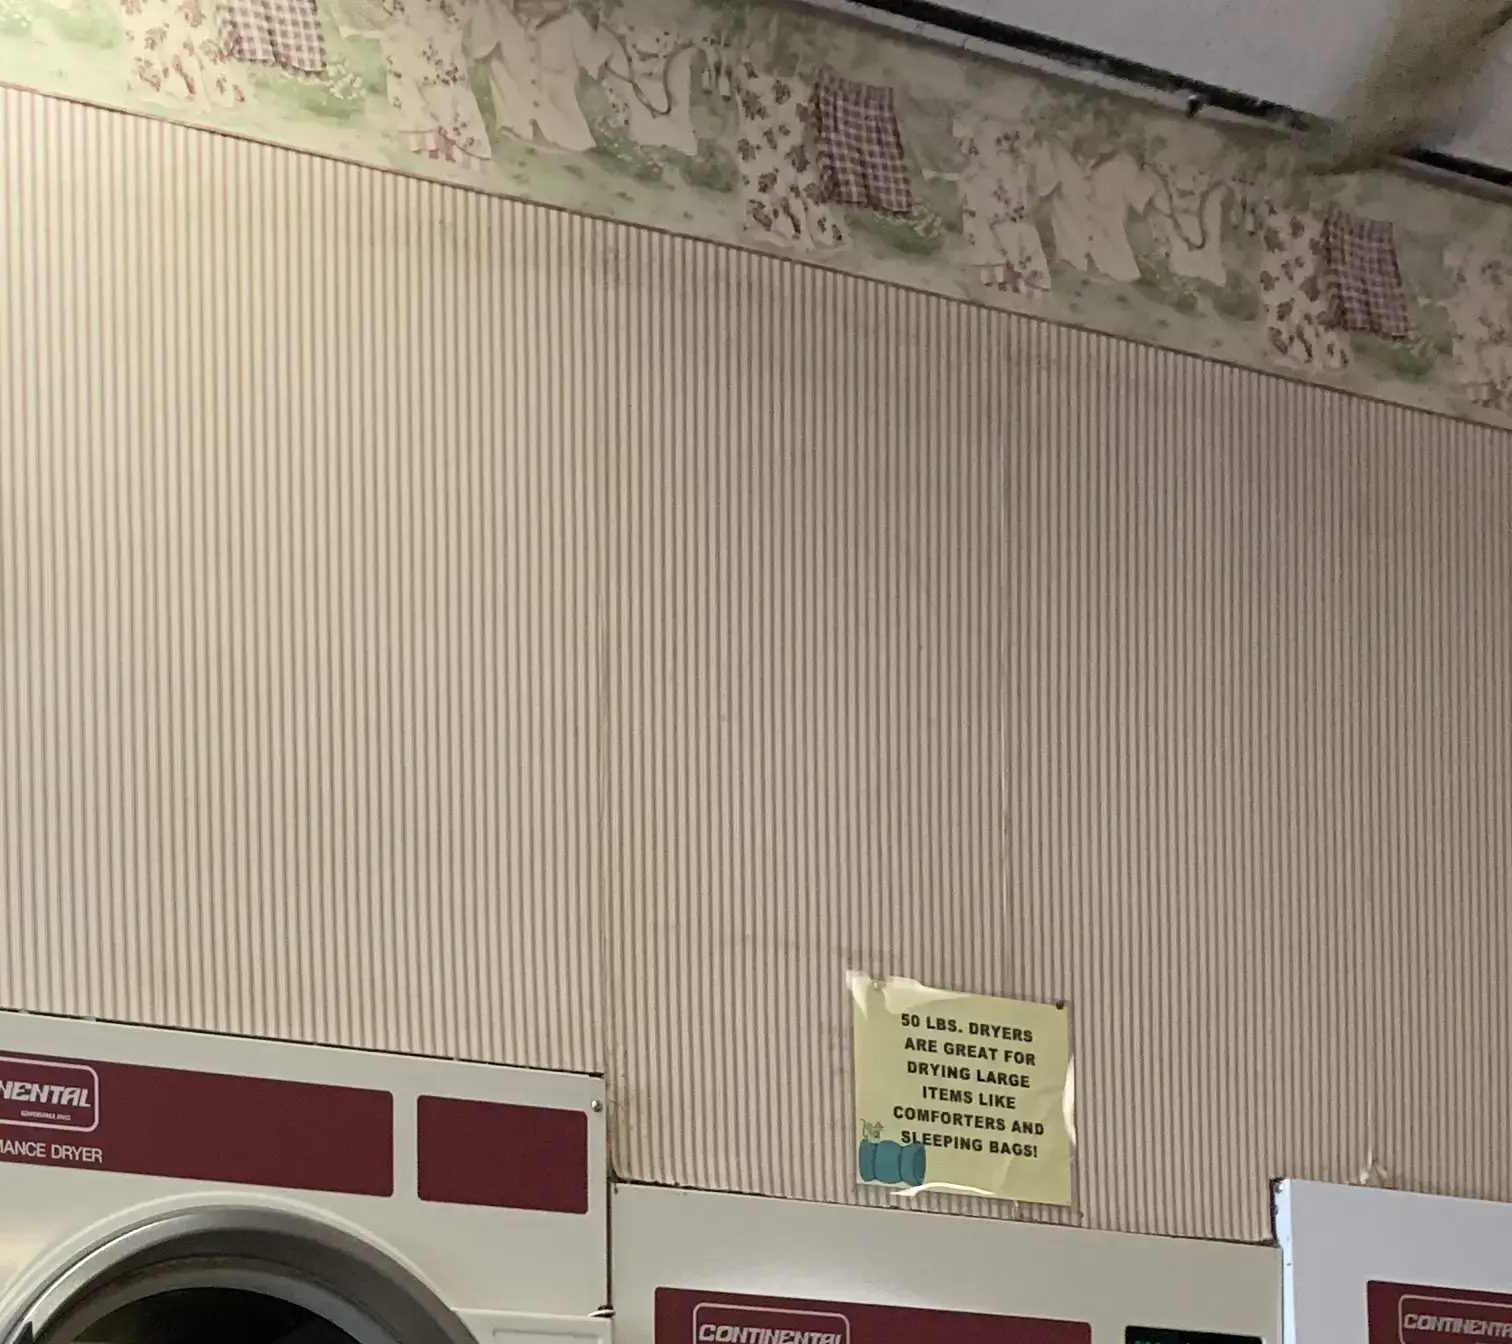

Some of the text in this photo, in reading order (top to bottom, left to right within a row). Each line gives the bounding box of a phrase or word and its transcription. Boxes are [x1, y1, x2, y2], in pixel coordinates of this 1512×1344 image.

[900, 1013, 1034, 1043] 50 LBS. DRYERS
[904, 1037, 1036, 1067] ARE GREAT FOR
[907, 1061, 1031, 1088] DRYING LARGE
[922, 1086, 1017, 1110] ITEMS LIKE
[893, 1106, 1045, 1136] COMFORTERS AND
[50, 1144, 103, 1164] DRYER
[900, 1130, 1039, 1159] SLEEPING BAGS!
[1403, 1312, 1512, 1339] CONTINENTA
